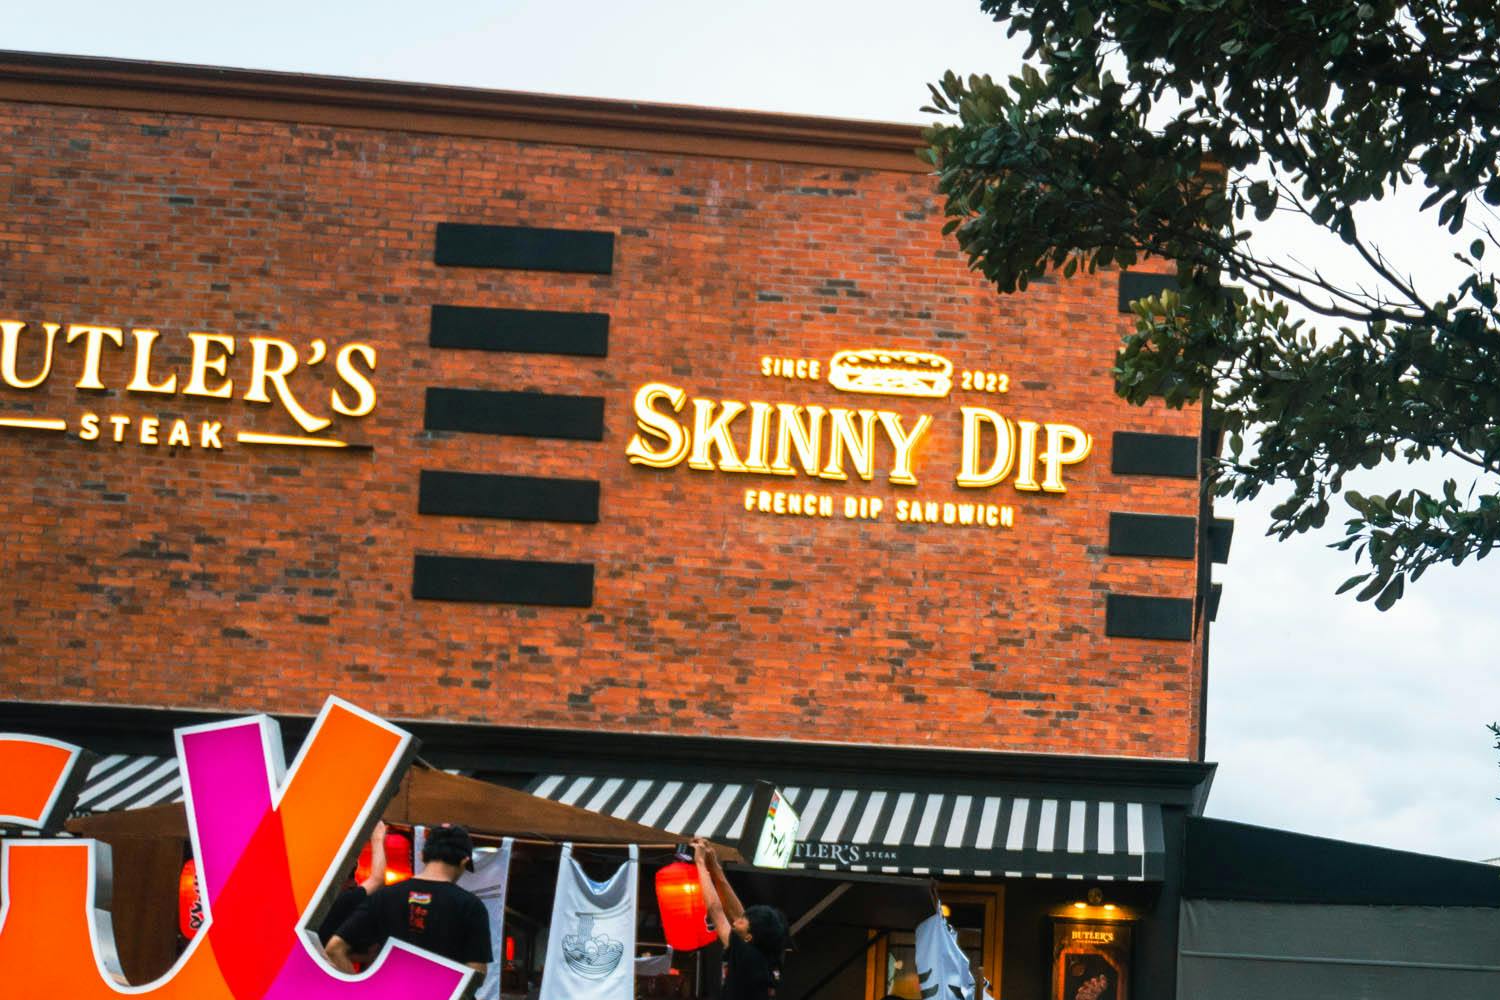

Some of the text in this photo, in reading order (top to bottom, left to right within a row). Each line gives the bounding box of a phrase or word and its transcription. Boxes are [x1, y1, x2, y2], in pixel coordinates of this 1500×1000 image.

[760, 356, 1010, 393] SINCE 2022
[79, 412, 223, 449] STEAK
[626, 382, 1094, 494] SKINNY DIP
[744, 488, 1014, 528] FRENCH DIP SANDWICH
[865, 851, 897, 860] STEAK
[1071, 931, 1114, 943] BUTLER'S
